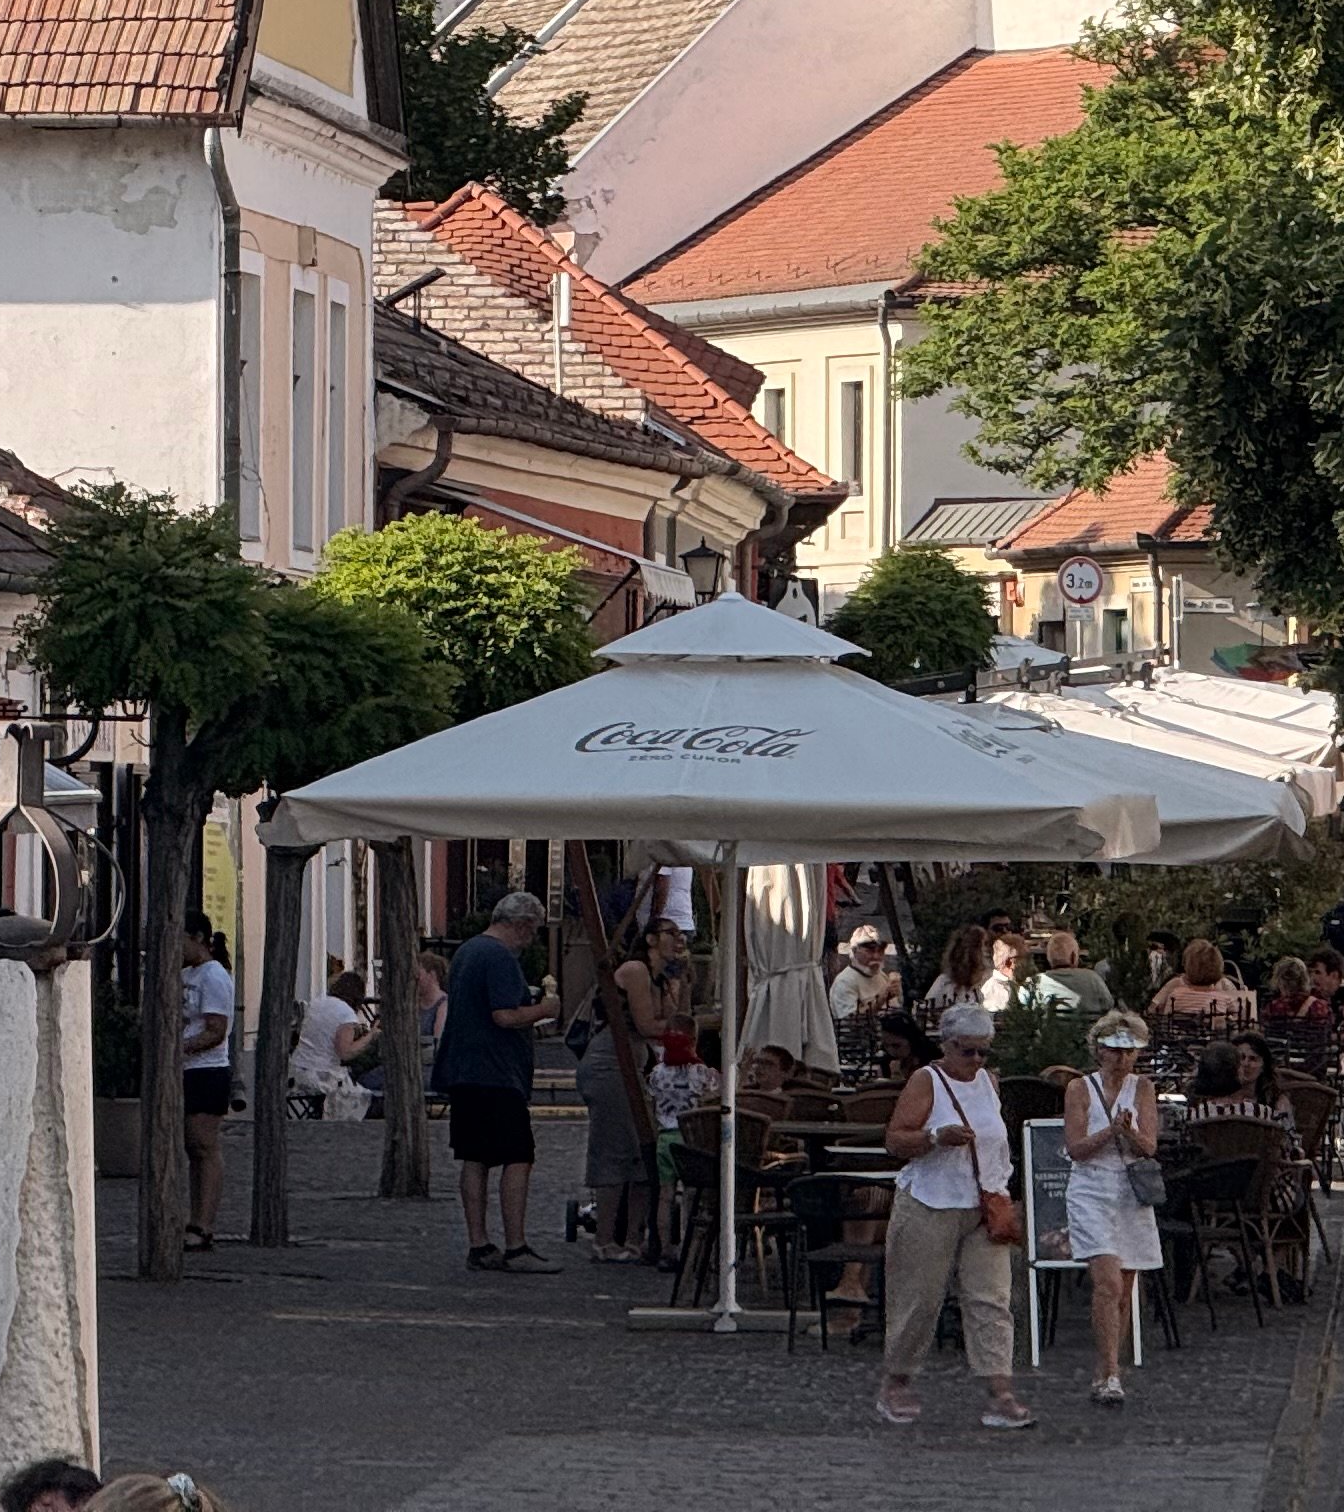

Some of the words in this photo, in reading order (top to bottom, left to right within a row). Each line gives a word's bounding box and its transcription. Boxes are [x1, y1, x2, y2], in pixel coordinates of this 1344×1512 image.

[574, 721, 816, 757] Coca-Cola
[628, 754, 673, 762] ZERO
[680, 754, 742, 764] CUKOR
